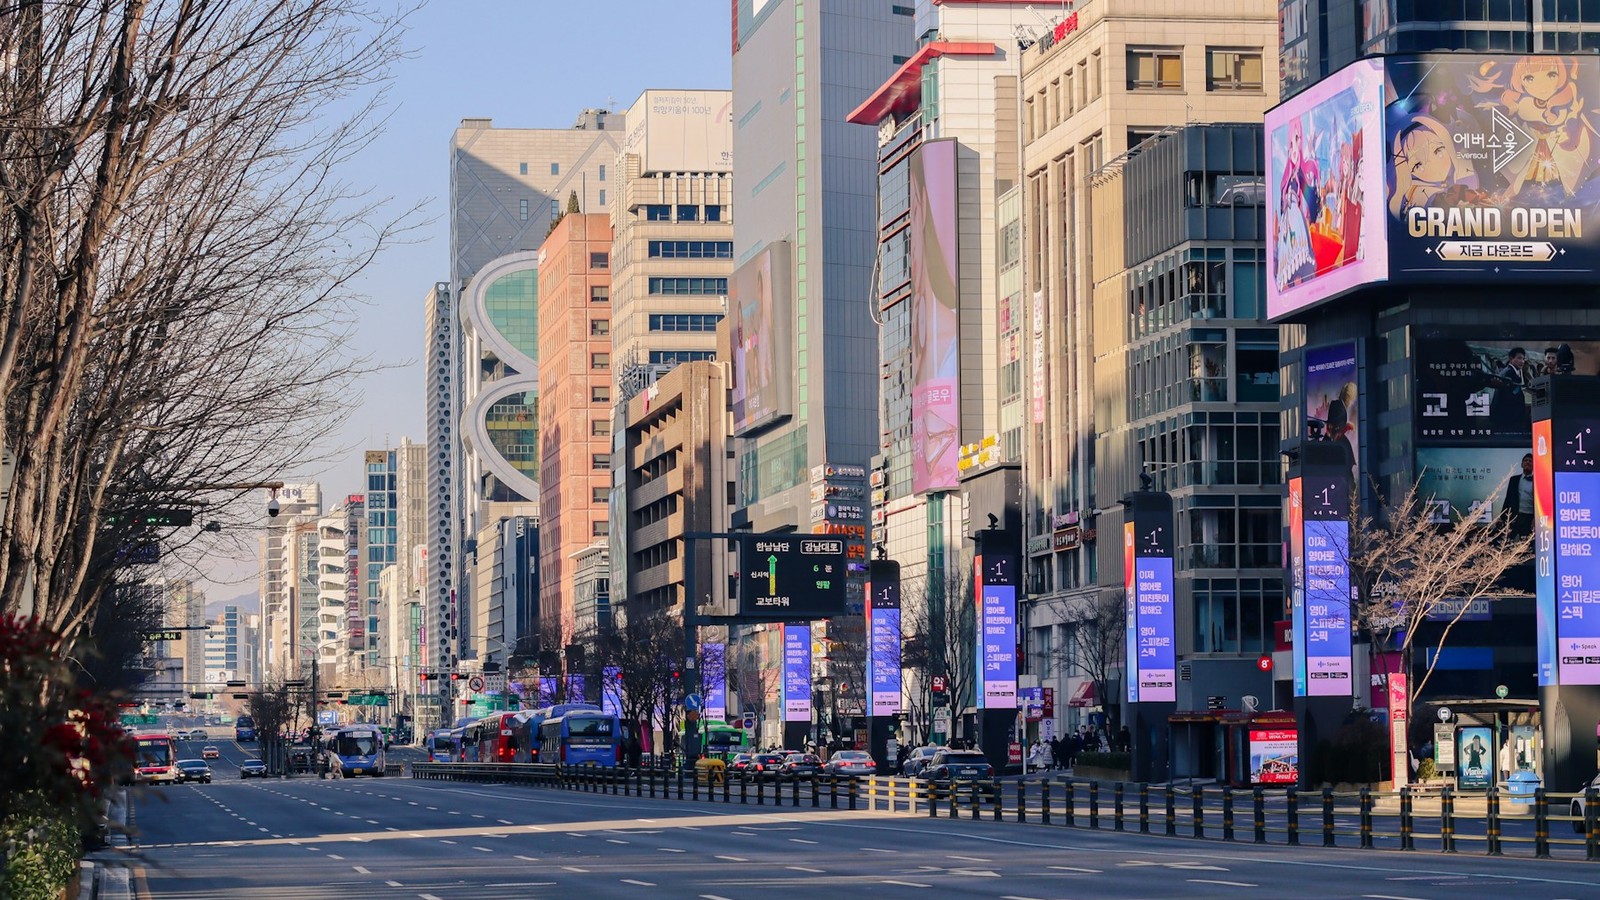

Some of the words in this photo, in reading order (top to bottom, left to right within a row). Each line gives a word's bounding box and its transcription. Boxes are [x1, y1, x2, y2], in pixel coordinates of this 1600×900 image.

[1453, 133, 1518, 154] 에버소울
[1408, 207, 1501, 238] GRAND
[1511, 208, 1582, 238] OPEN
[1460, 244, 1483, 257] 지금
[1487, 244, 1534, 257] 다운로드
[1560, 491, 1581, 504] 이제
[1560, 508, 1591, 522] 영어로
[1560, 526, 1600, 539] 미친듯이
[804, 542, 839, 552] 강남대로
[1308, 536, 1327, 547] 이제
[1561, 543, 1592, 556] 말해요
[1308, 550, 1335, 561] 영어로
[1139, 570, 1155, 579] 이제
[1139, 581, 1162, 591] 영어로
[1562, 575, 1582, 587] 영어
[756, 596, 790, 606] 교보타워
[1140, 593, 1170, 603] 미친듯이
[1309, 605, 1328, 616] 영어
[1562, 606, 1583, 619] 스픽
[1140, 626, 1156, 636] 영어
[1310, 630, 1328, 641] 스픽
[1141, 637, 1170, 647] 스피킹은
[1141, 647, 1157, 657] 스픽
